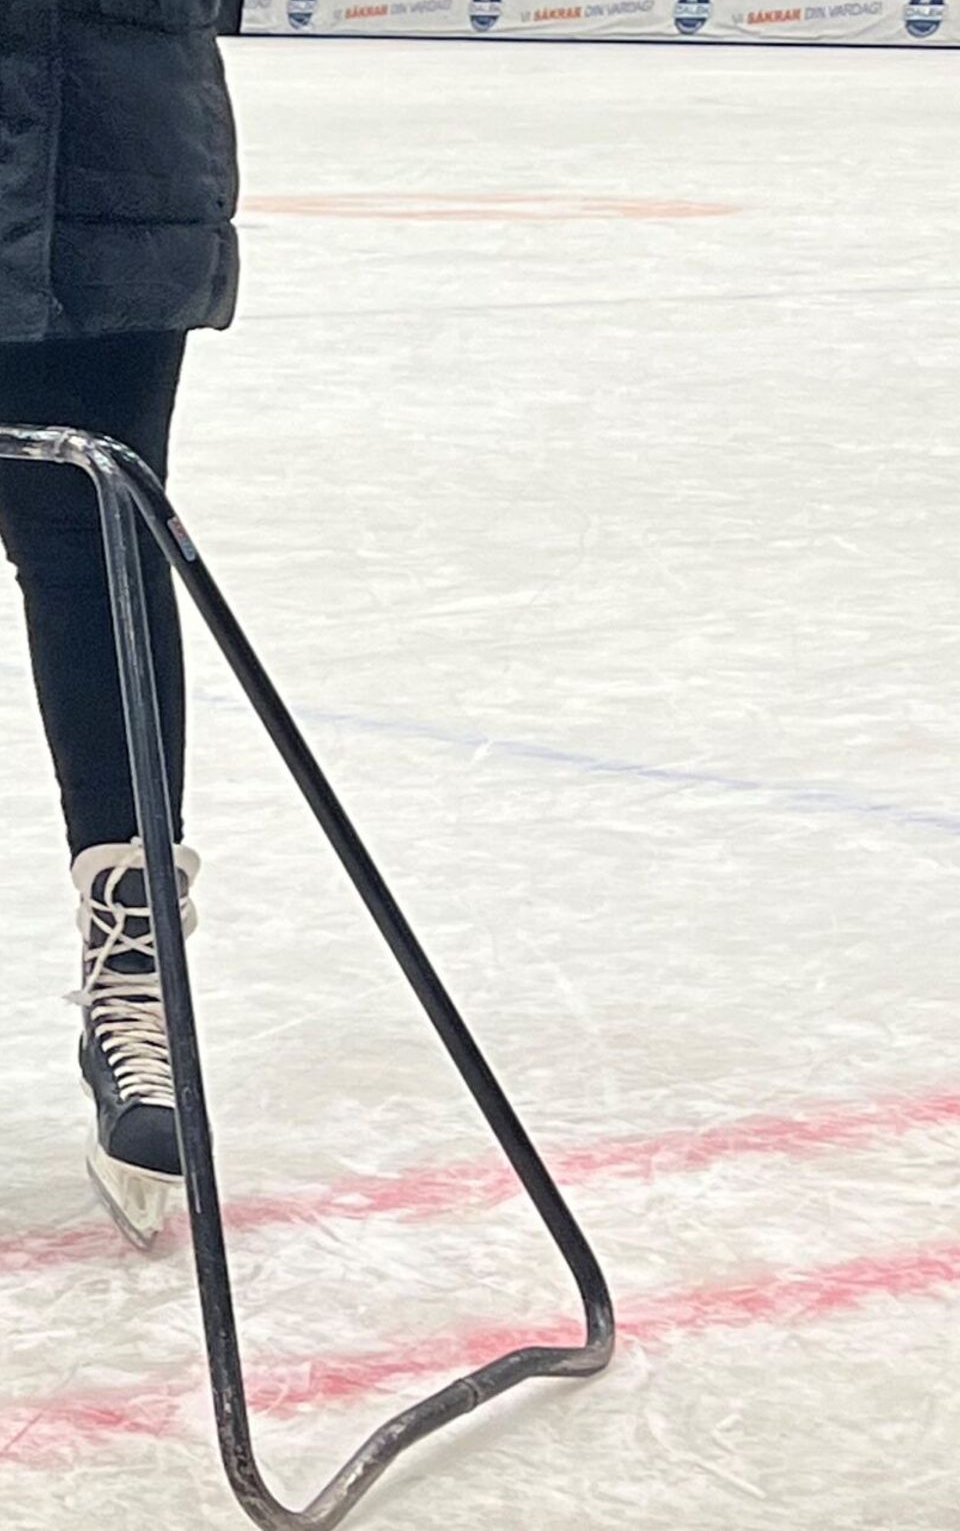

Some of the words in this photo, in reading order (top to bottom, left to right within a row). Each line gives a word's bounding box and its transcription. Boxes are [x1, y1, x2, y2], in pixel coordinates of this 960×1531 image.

[533, 6, 582, 22] SÄKRAR
[747, 8, 801, 24] SÄKRAR
[804, 6, 825, 20] DIN
